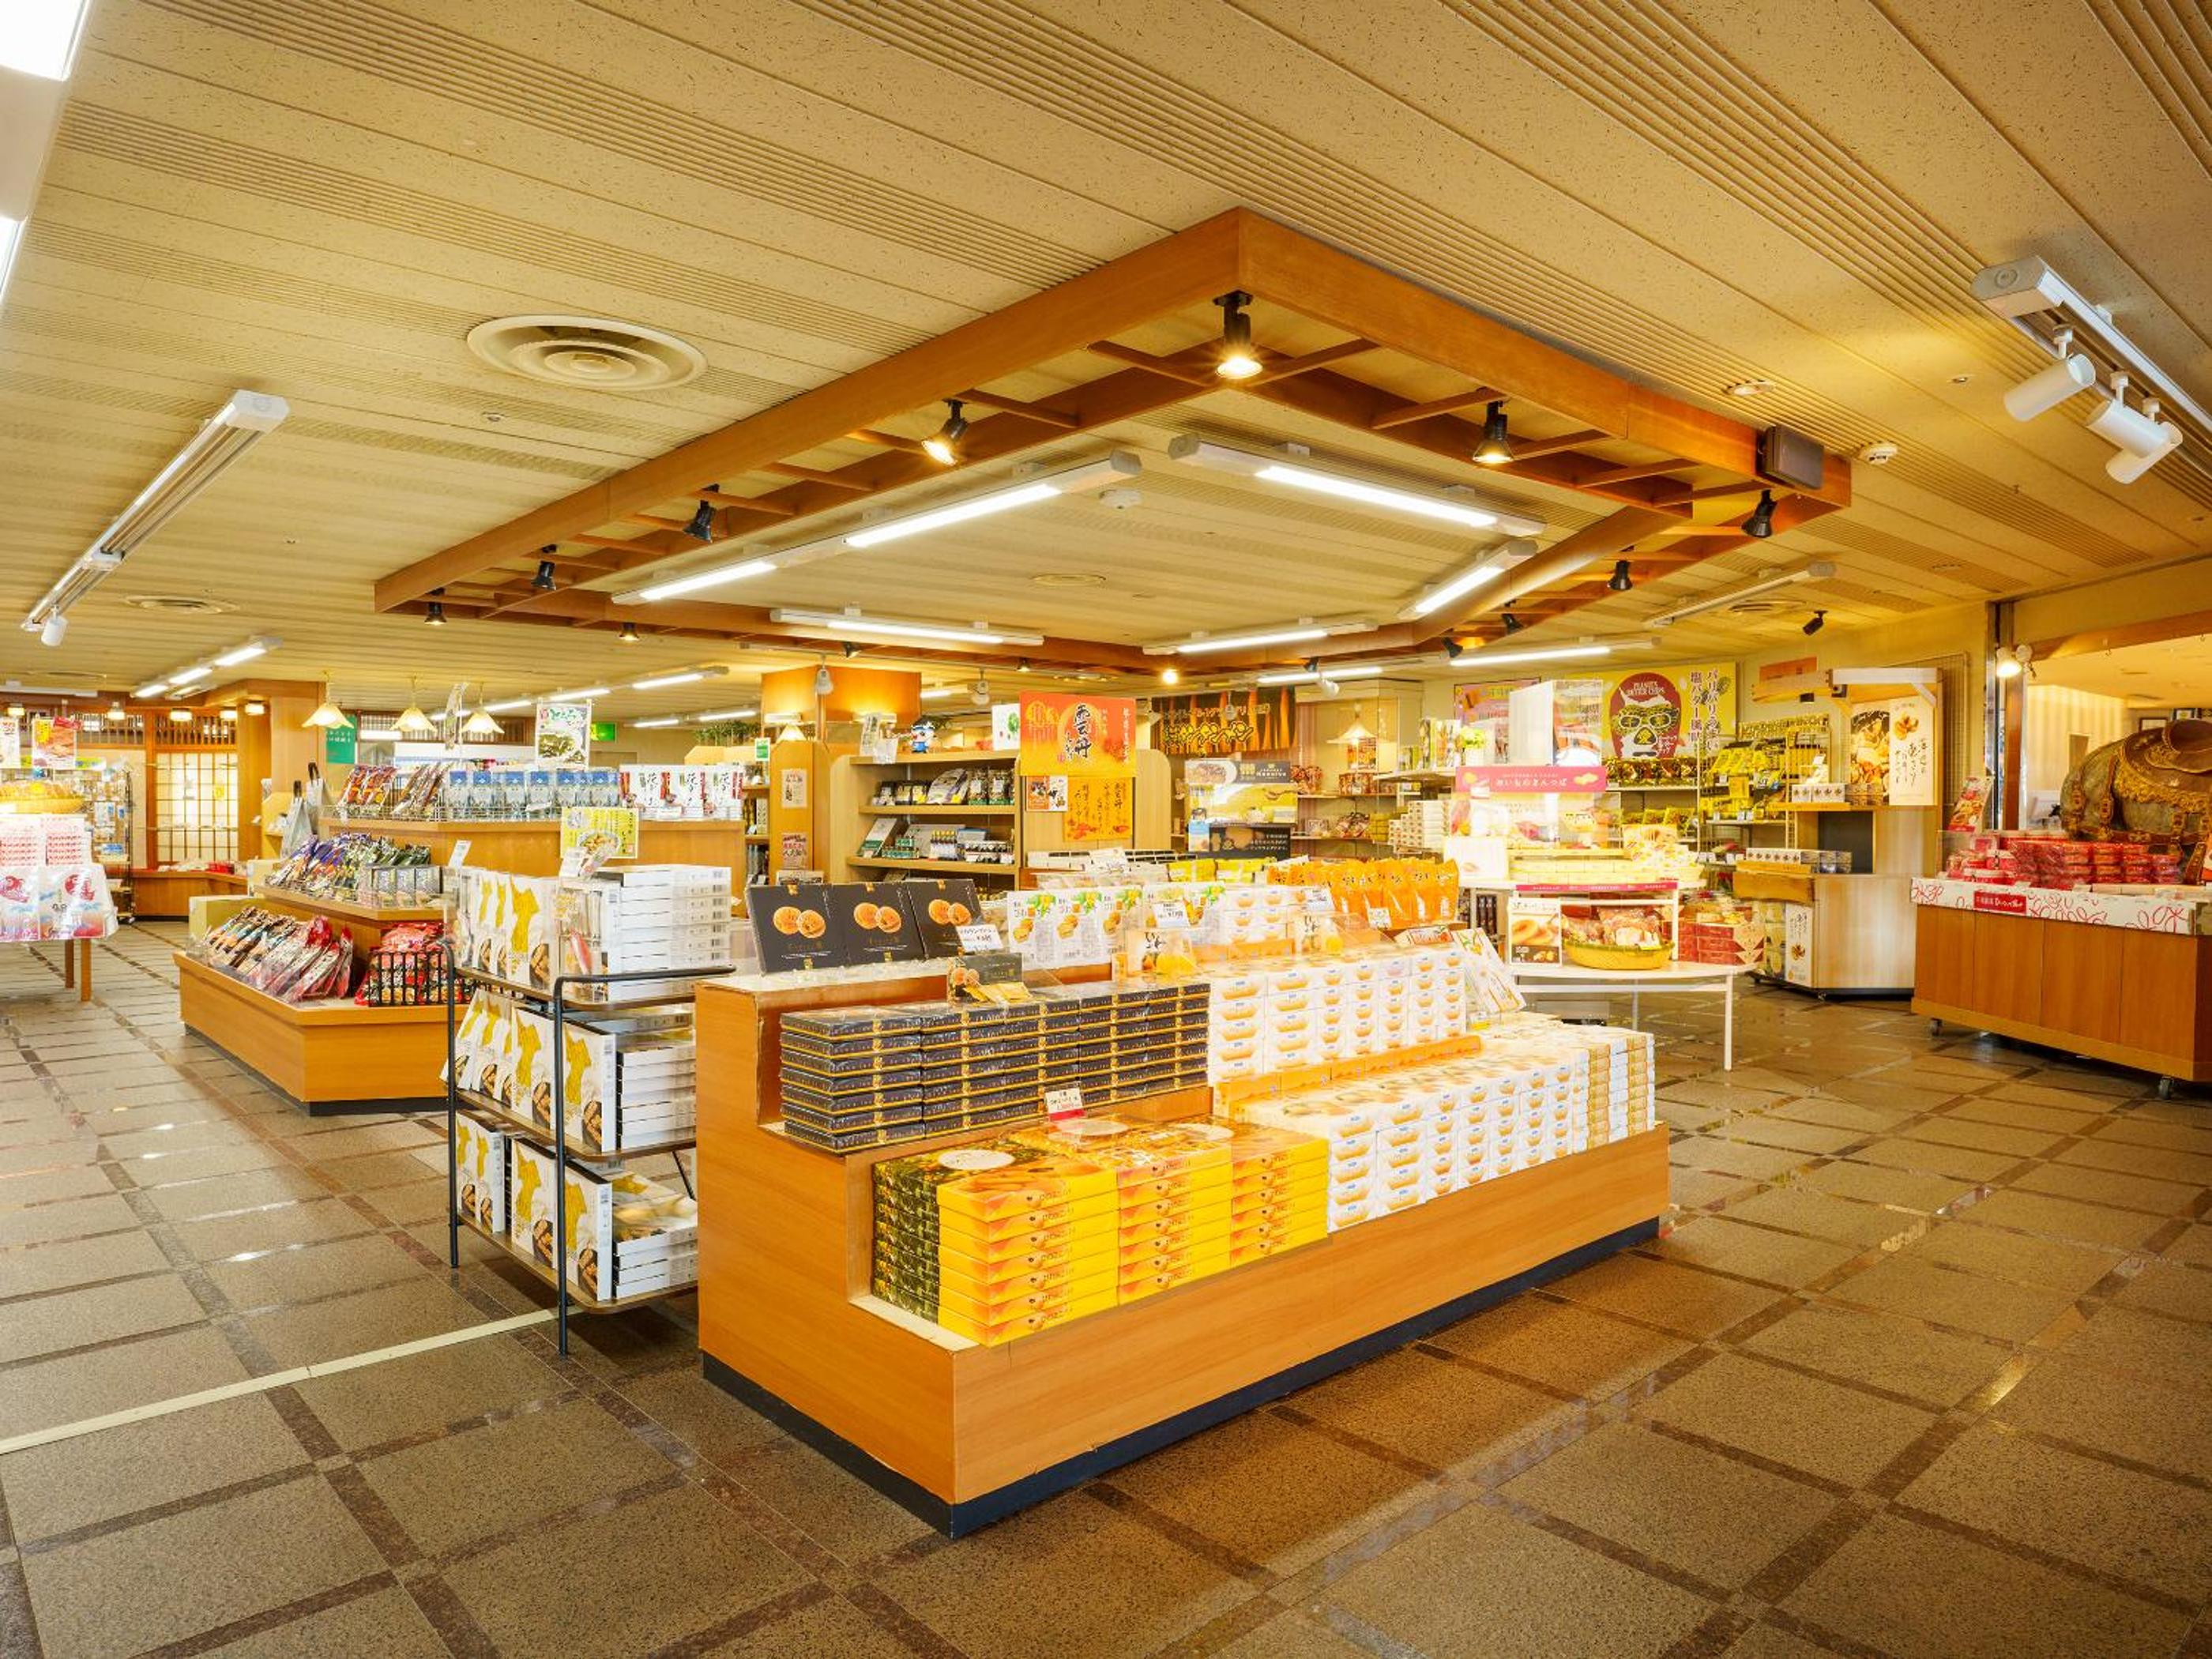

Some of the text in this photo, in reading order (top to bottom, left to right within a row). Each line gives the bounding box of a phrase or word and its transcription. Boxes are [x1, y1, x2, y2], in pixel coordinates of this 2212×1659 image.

[1690, 672, 1702, 742] 塩バター風味
